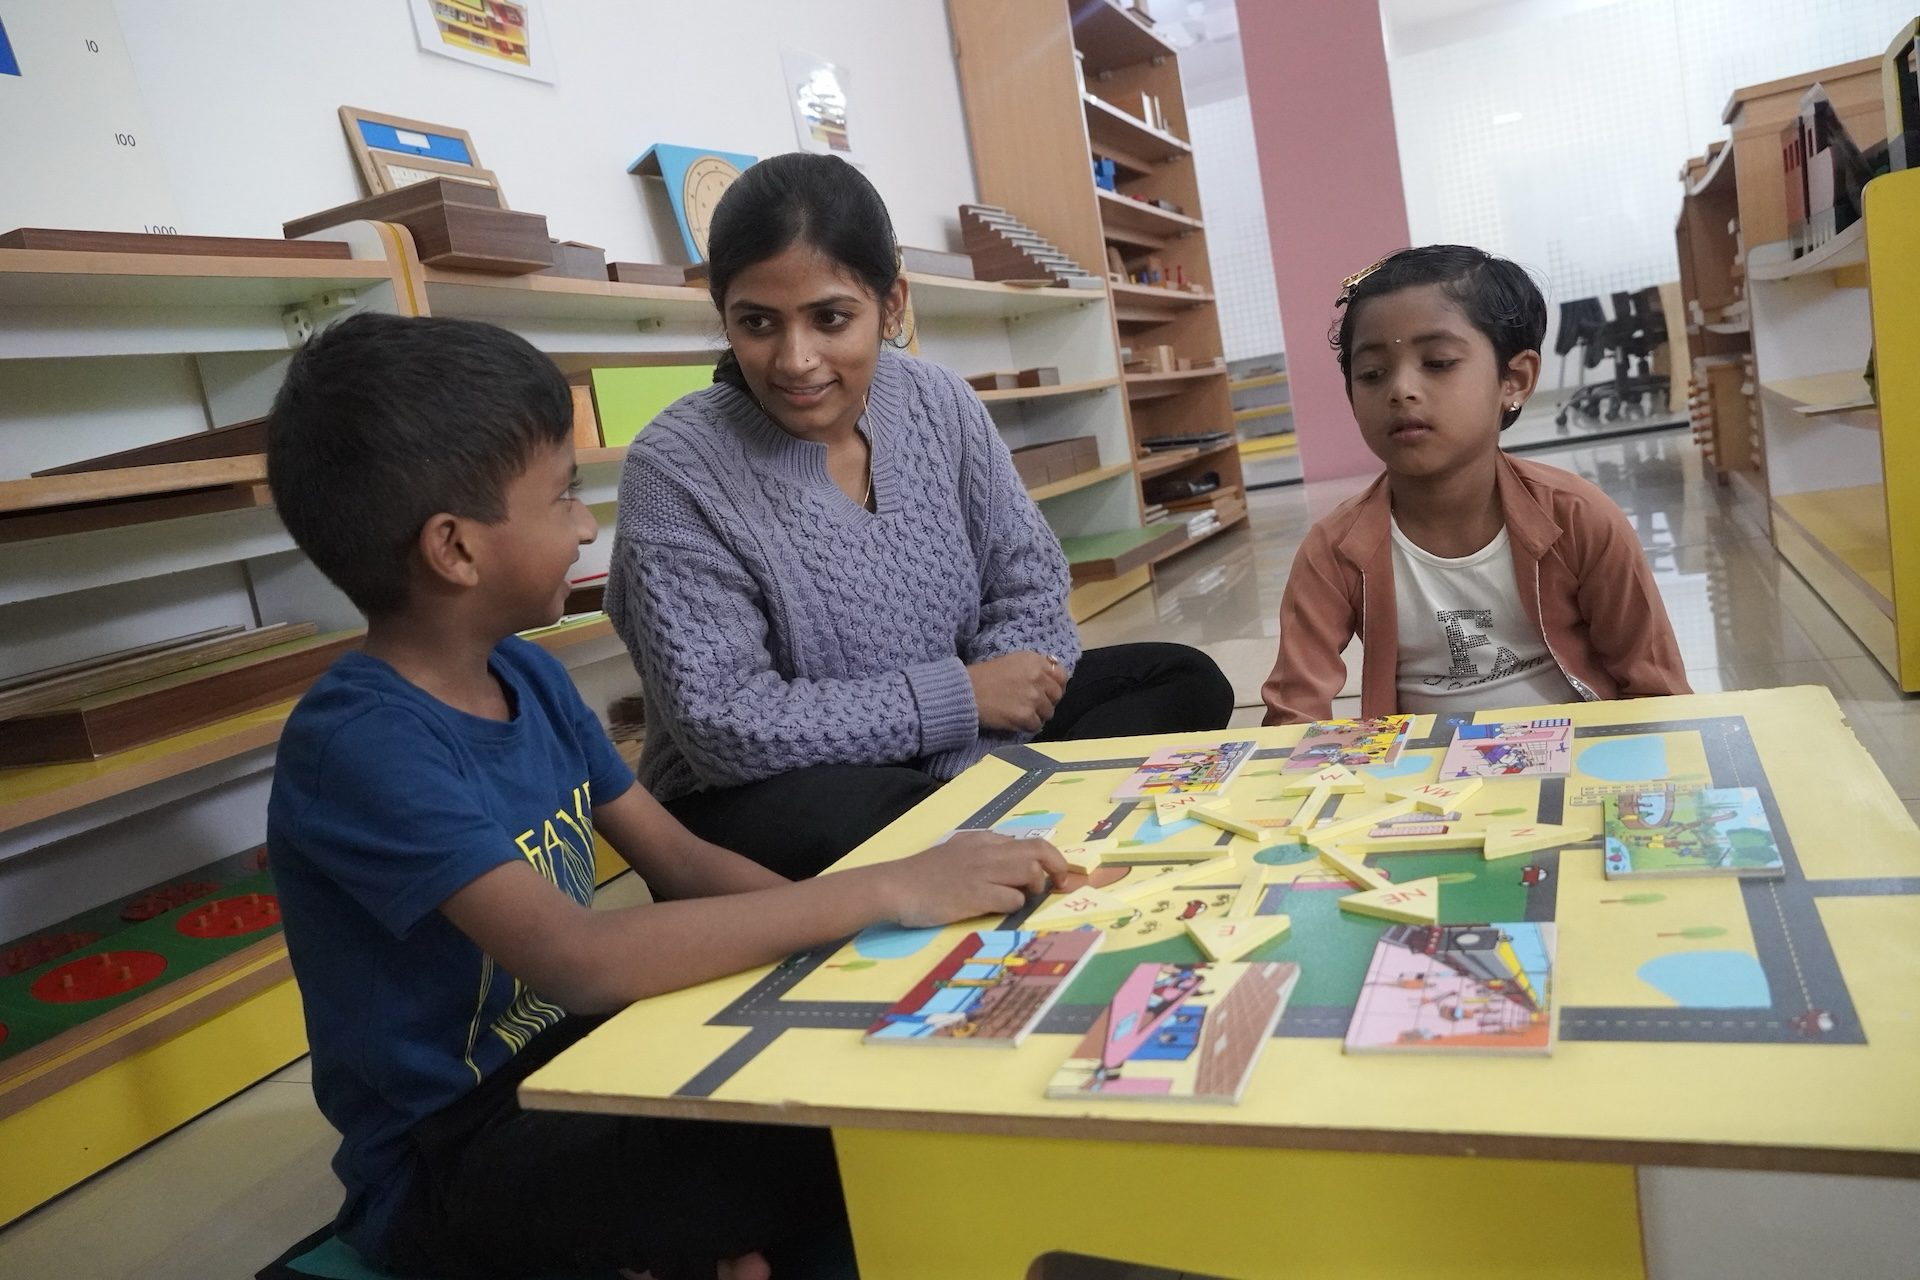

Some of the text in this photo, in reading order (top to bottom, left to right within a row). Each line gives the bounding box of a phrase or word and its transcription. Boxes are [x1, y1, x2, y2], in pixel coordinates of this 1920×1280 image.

[85, 39, 99, 53] 10
[115, 133, 136, 147] 100
[1413, 785, 1460, 798] NW
[1160, 796, 1196, 810] SW
[1379, 888, 1427, 905] NE
[1064, 897, 1098, 911] SE
[1217, 924, 1236, 937] E
